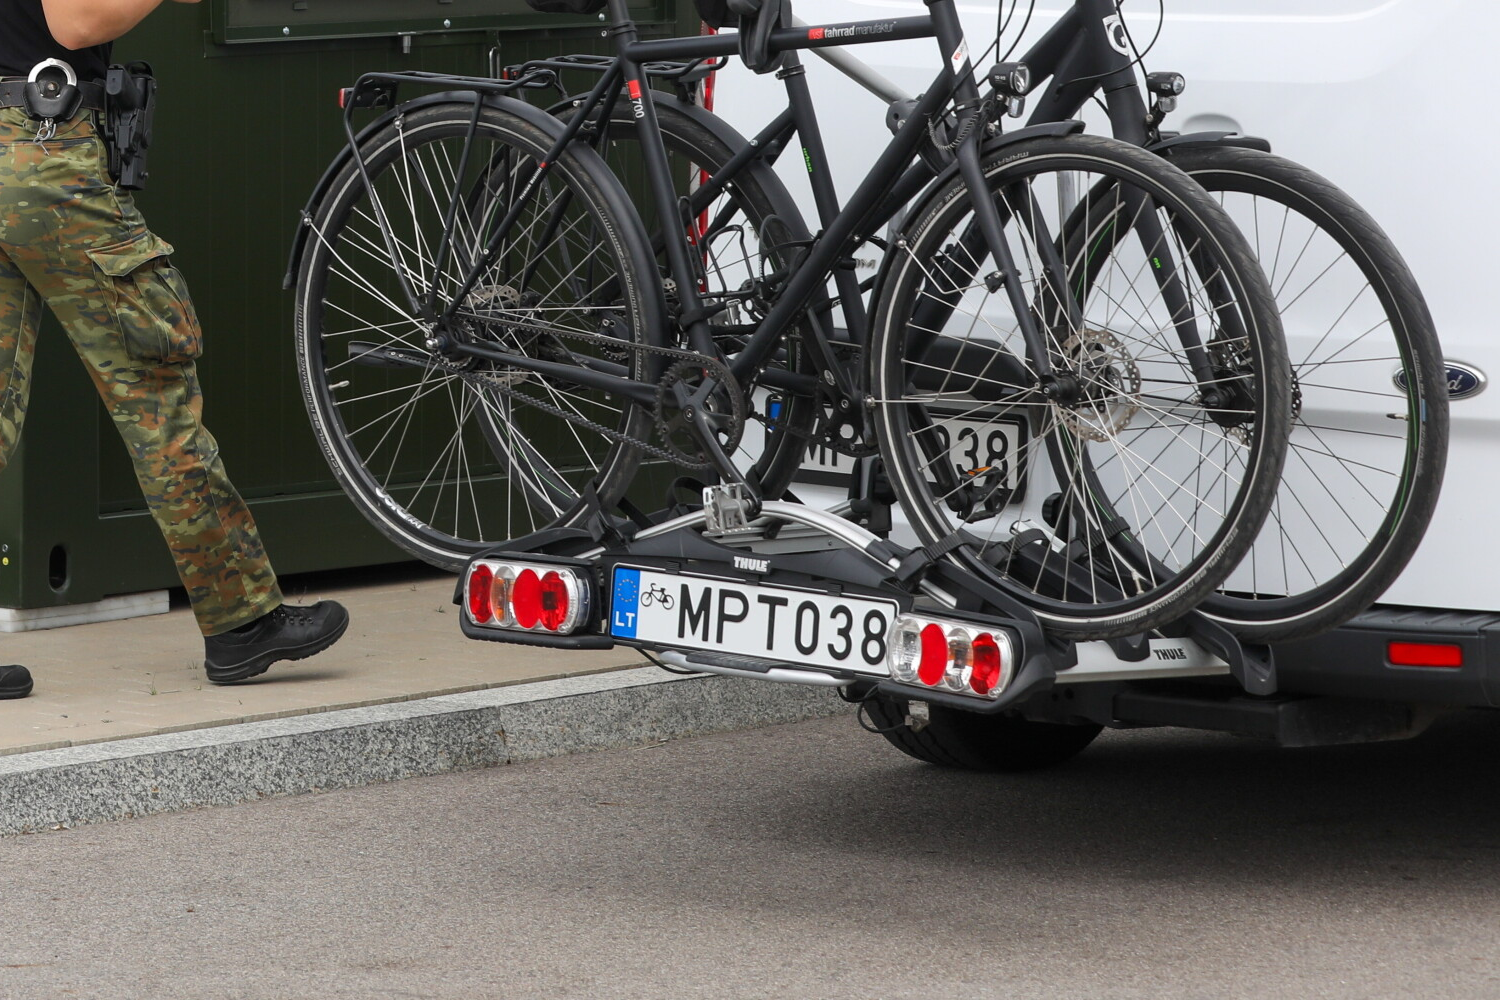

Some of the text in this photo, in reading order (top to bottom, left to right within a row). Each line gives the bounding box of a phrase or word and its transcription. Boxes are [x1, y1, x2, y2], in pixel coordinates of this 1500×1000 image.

[733, 556, 768, 573] THULE
[615, 610, 635, 628] LT
[1152, 647, 1188, 661] THULE
